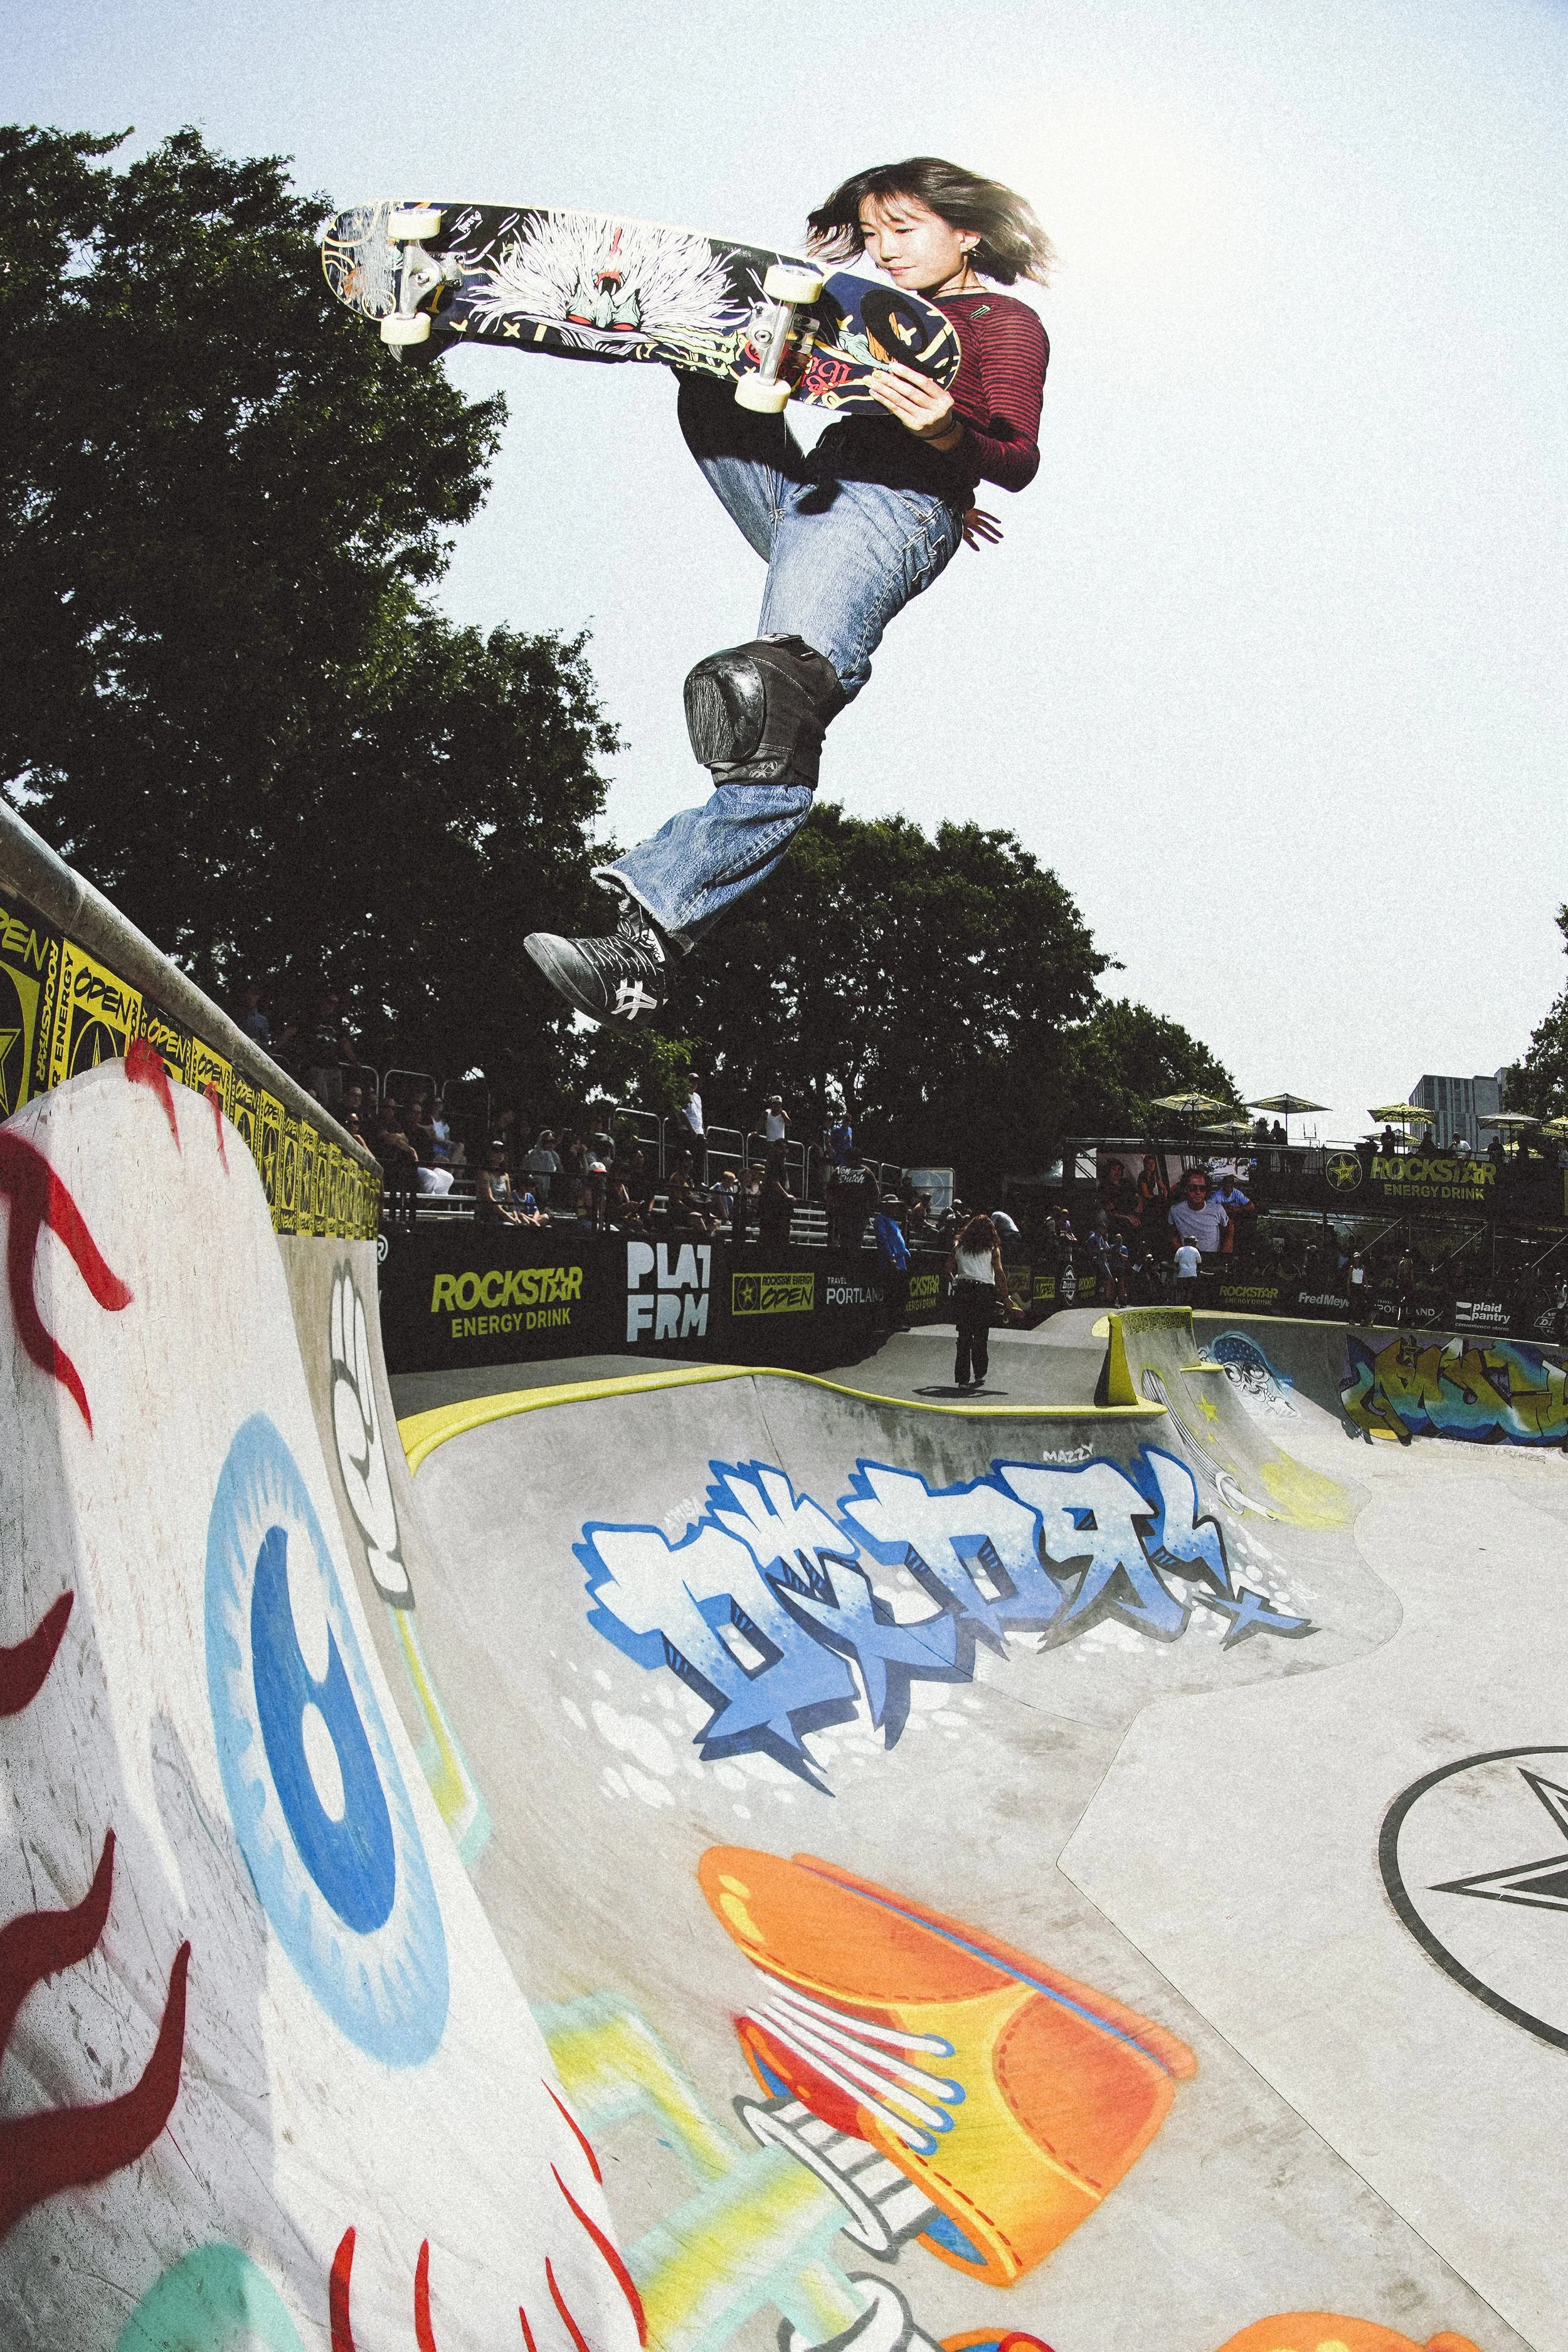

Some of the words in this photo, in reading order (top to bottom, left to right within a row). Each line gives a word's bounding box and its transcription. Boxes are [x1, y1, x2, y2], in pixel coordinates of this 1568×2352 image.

[55, 951, 74, 1063] ENERGY
[73, 967, 132, 1026] OPEN
[36, 940, 59, 1082] ROCKSTAR
[147, 1017, 187, 1063] OPEN
[198, 1053, 226, 1089] OPEN
[235, 1079, 258, 1110] OPEN
[839, 1174, 865, 1184] Dutch
[1370, 1157, 1496, 1185] ROCKSTAR
[1384, 1184, 1439, 1198] ENERGY
[1442, 1187, 1485, 1200] DRINK
[431, 1266, 583, 1312] ROCKSTAR
[762, 1276, 792, 1286] ROCKSTAR
[792, 1276, 813, 1285] ENERGY
[909, 1274, 940, 1296] CKSTAR
[1219, 1285, 1279, 1299] ROCKSTAR
[761, 1285, 813, 1310] OPEN
[1225, 1297, 1251, 1305] ENERGY
[1472, 1301, 1502, 1313] plaid
[452, 1313, 523, 1338] ENERGY
[526, 1307, 571, 1330] DRINK
[627, 1293, 709, 1342] FRM
[1454, 1322, 1491, 1330] convenience
[1491, 1323, 1510, 1332] stores
[1471, 1311, 1510, 1324] pantry
[1042, 1443, 1094, 1463] MAZZY
